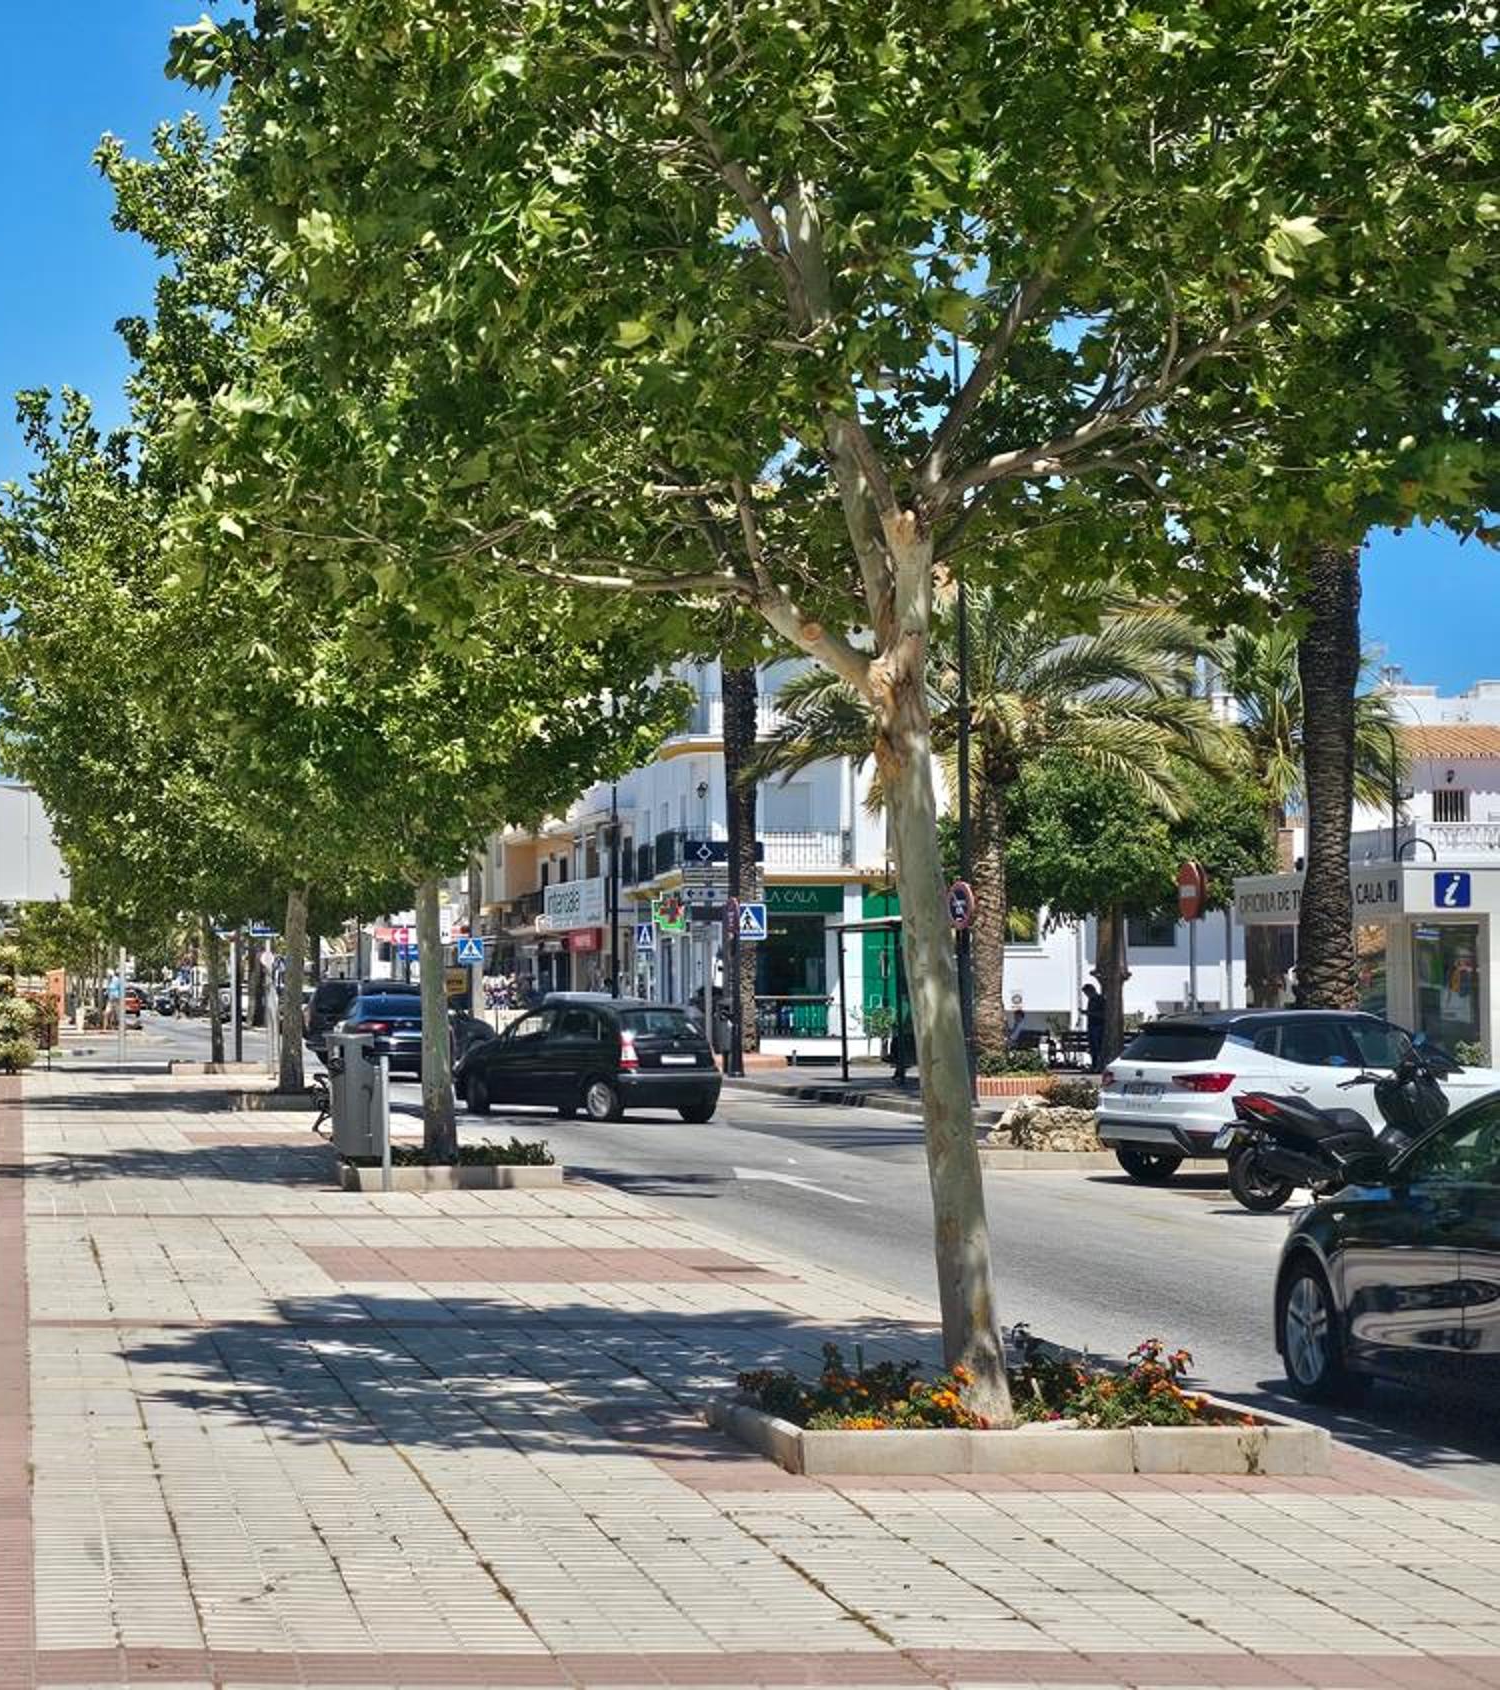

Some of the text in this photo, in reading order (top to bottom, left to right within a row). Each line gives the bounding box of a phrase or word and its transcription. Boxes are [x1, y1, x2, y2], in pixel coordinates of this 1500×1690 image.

[783, 890, 819, 903] CALA
[1239, 892, 1275, 914] OFICINA
[1277, 890, 1290, 912] DE
[1355, 880, 1383, 905] CALA
